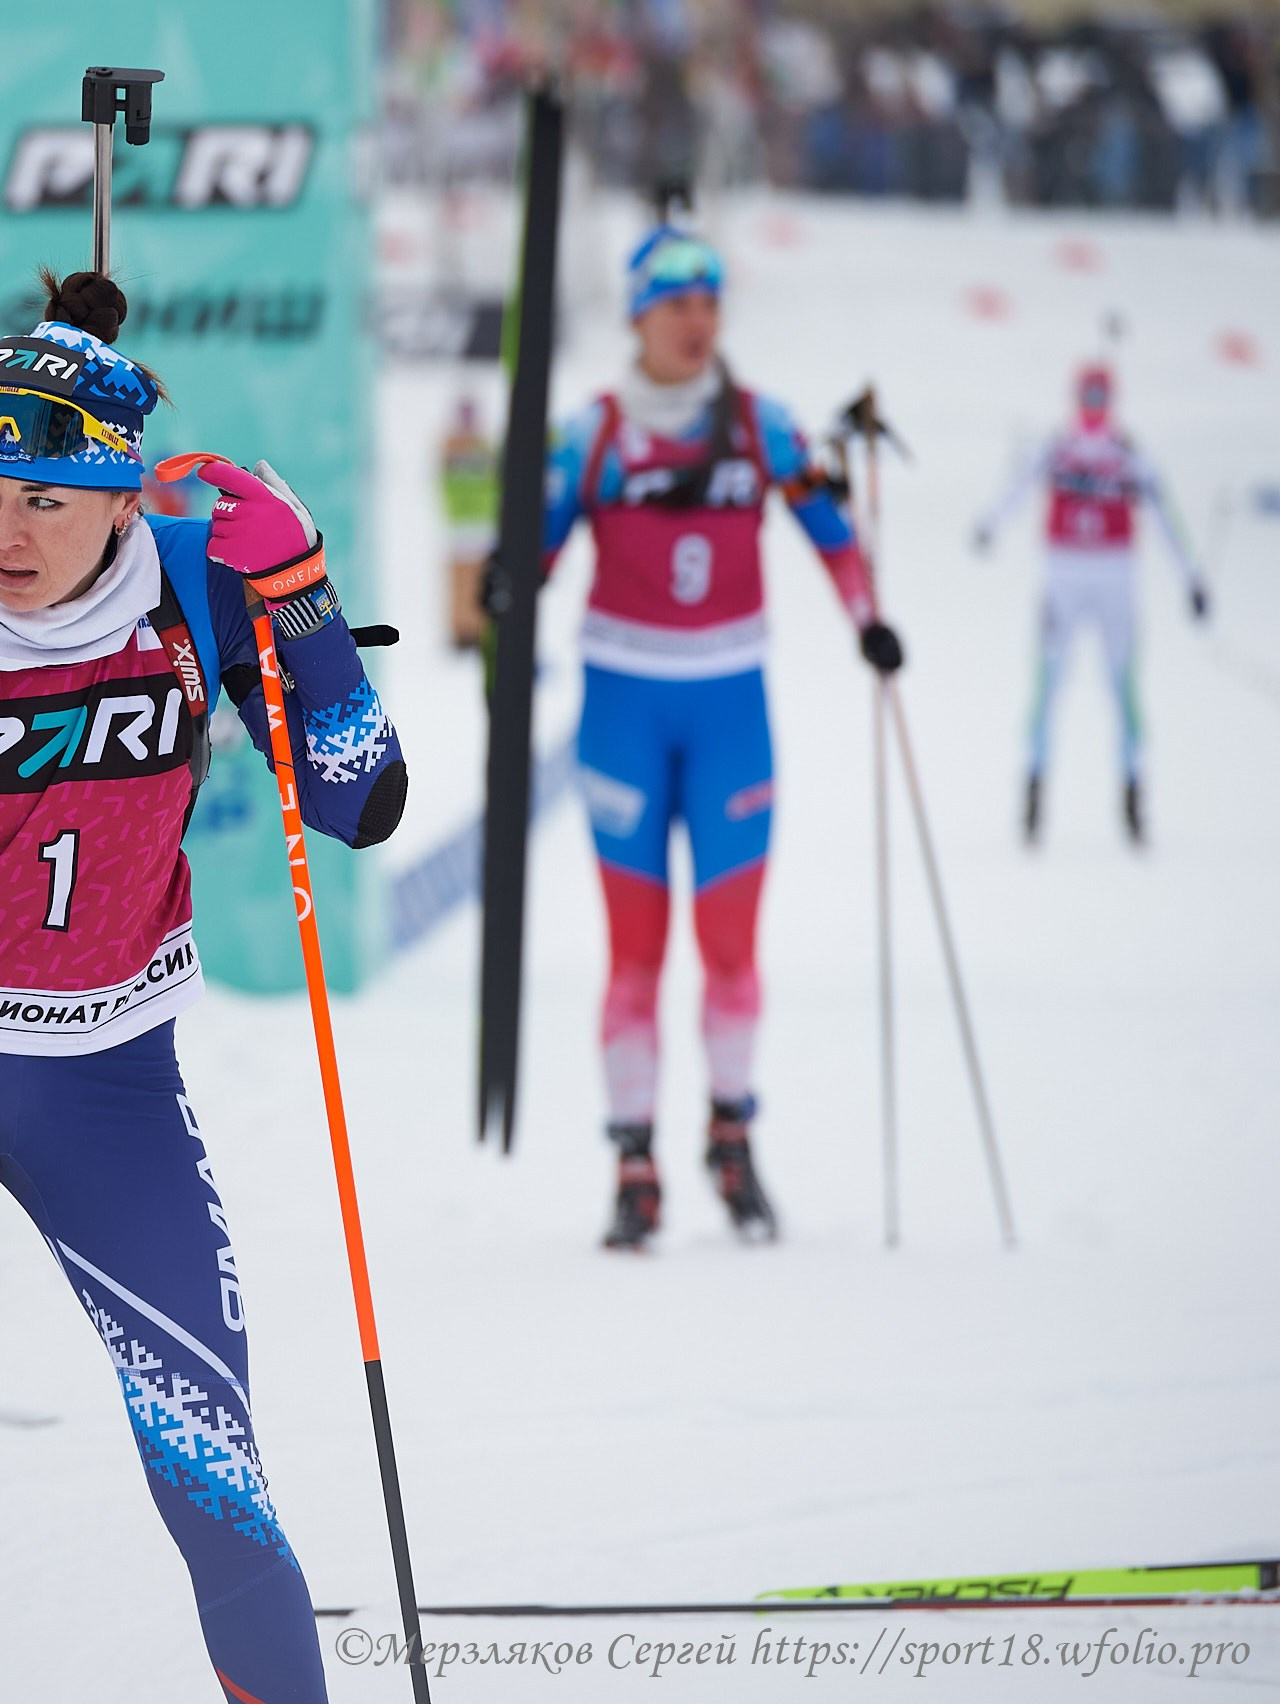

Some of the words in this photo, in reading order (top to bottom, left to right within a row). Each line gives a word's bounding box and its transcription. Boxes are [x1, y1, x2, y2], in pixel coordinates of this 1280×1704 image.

[4, 126, 315, 209] PARI
[672, 532, 713, 605] 9
[38, 829, 81, 932] 1
